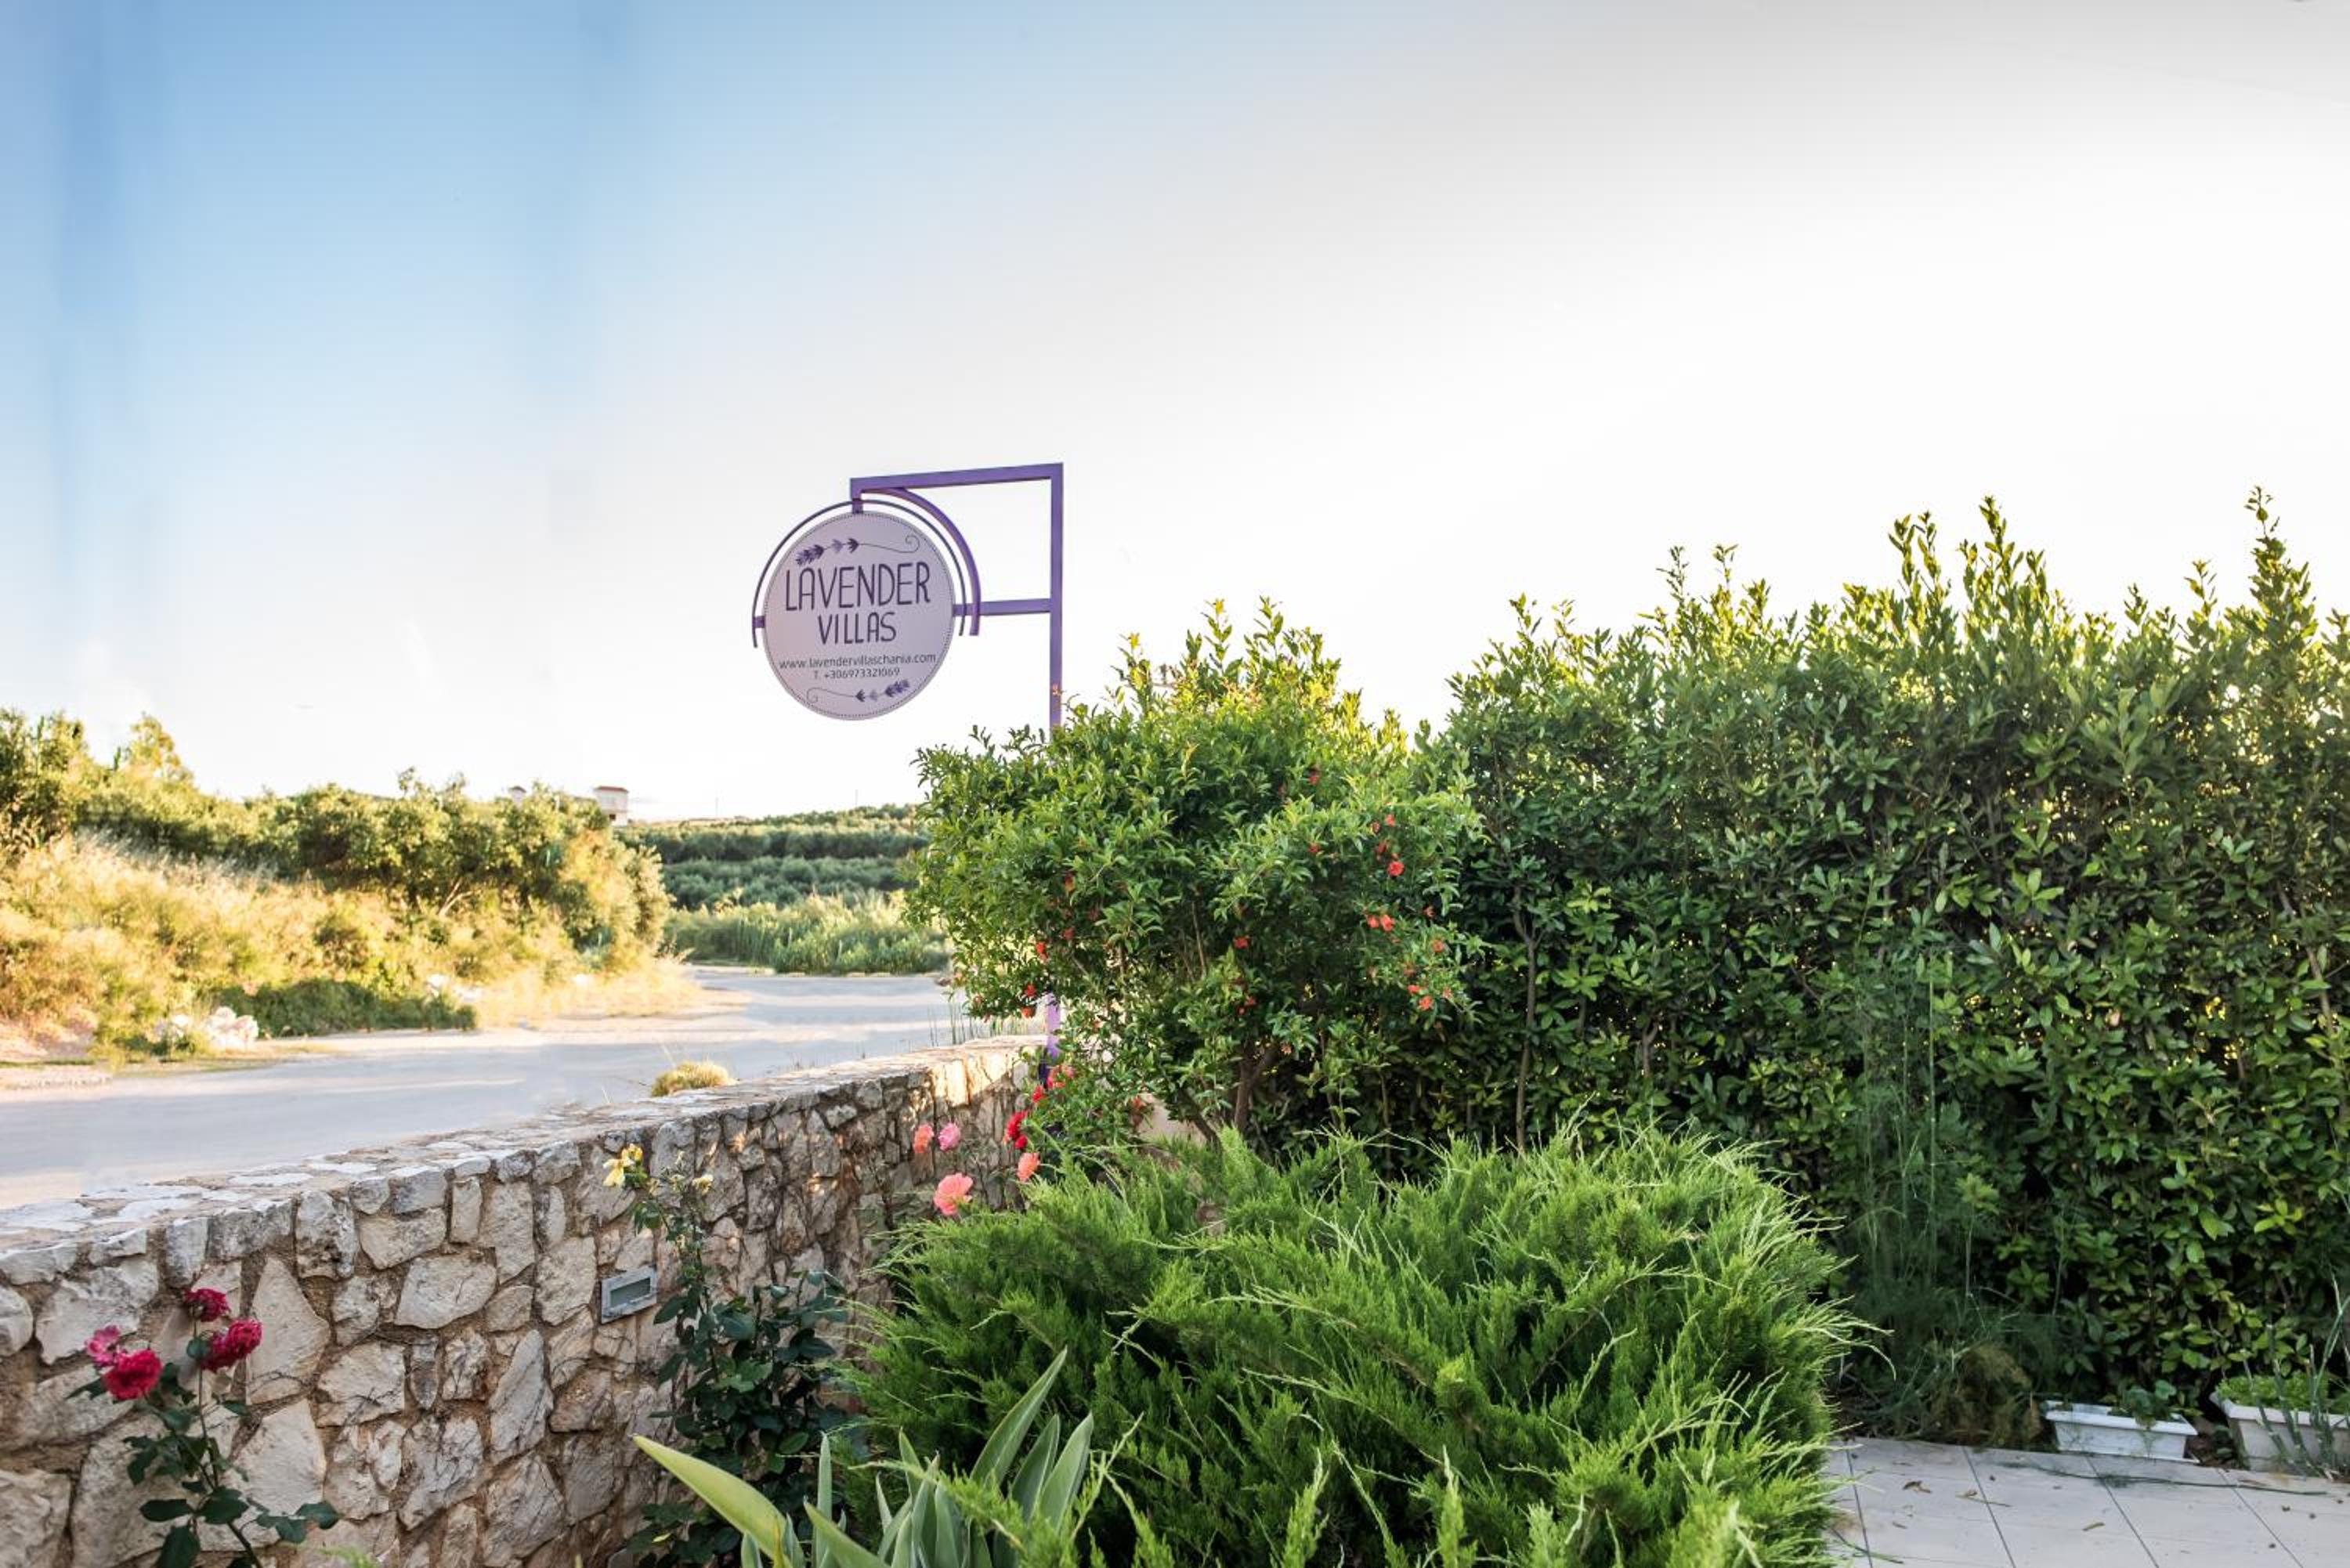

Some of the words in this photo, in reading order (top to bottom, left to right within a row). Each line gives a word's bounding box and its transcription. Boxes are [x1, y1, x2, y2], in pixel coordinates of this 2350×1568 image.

[786, 562, 931, 611] LAVENDER
[818, 612, 897, 645] VILLAS
[779, 653, 936, 668] www.lavendervillaschania.com
